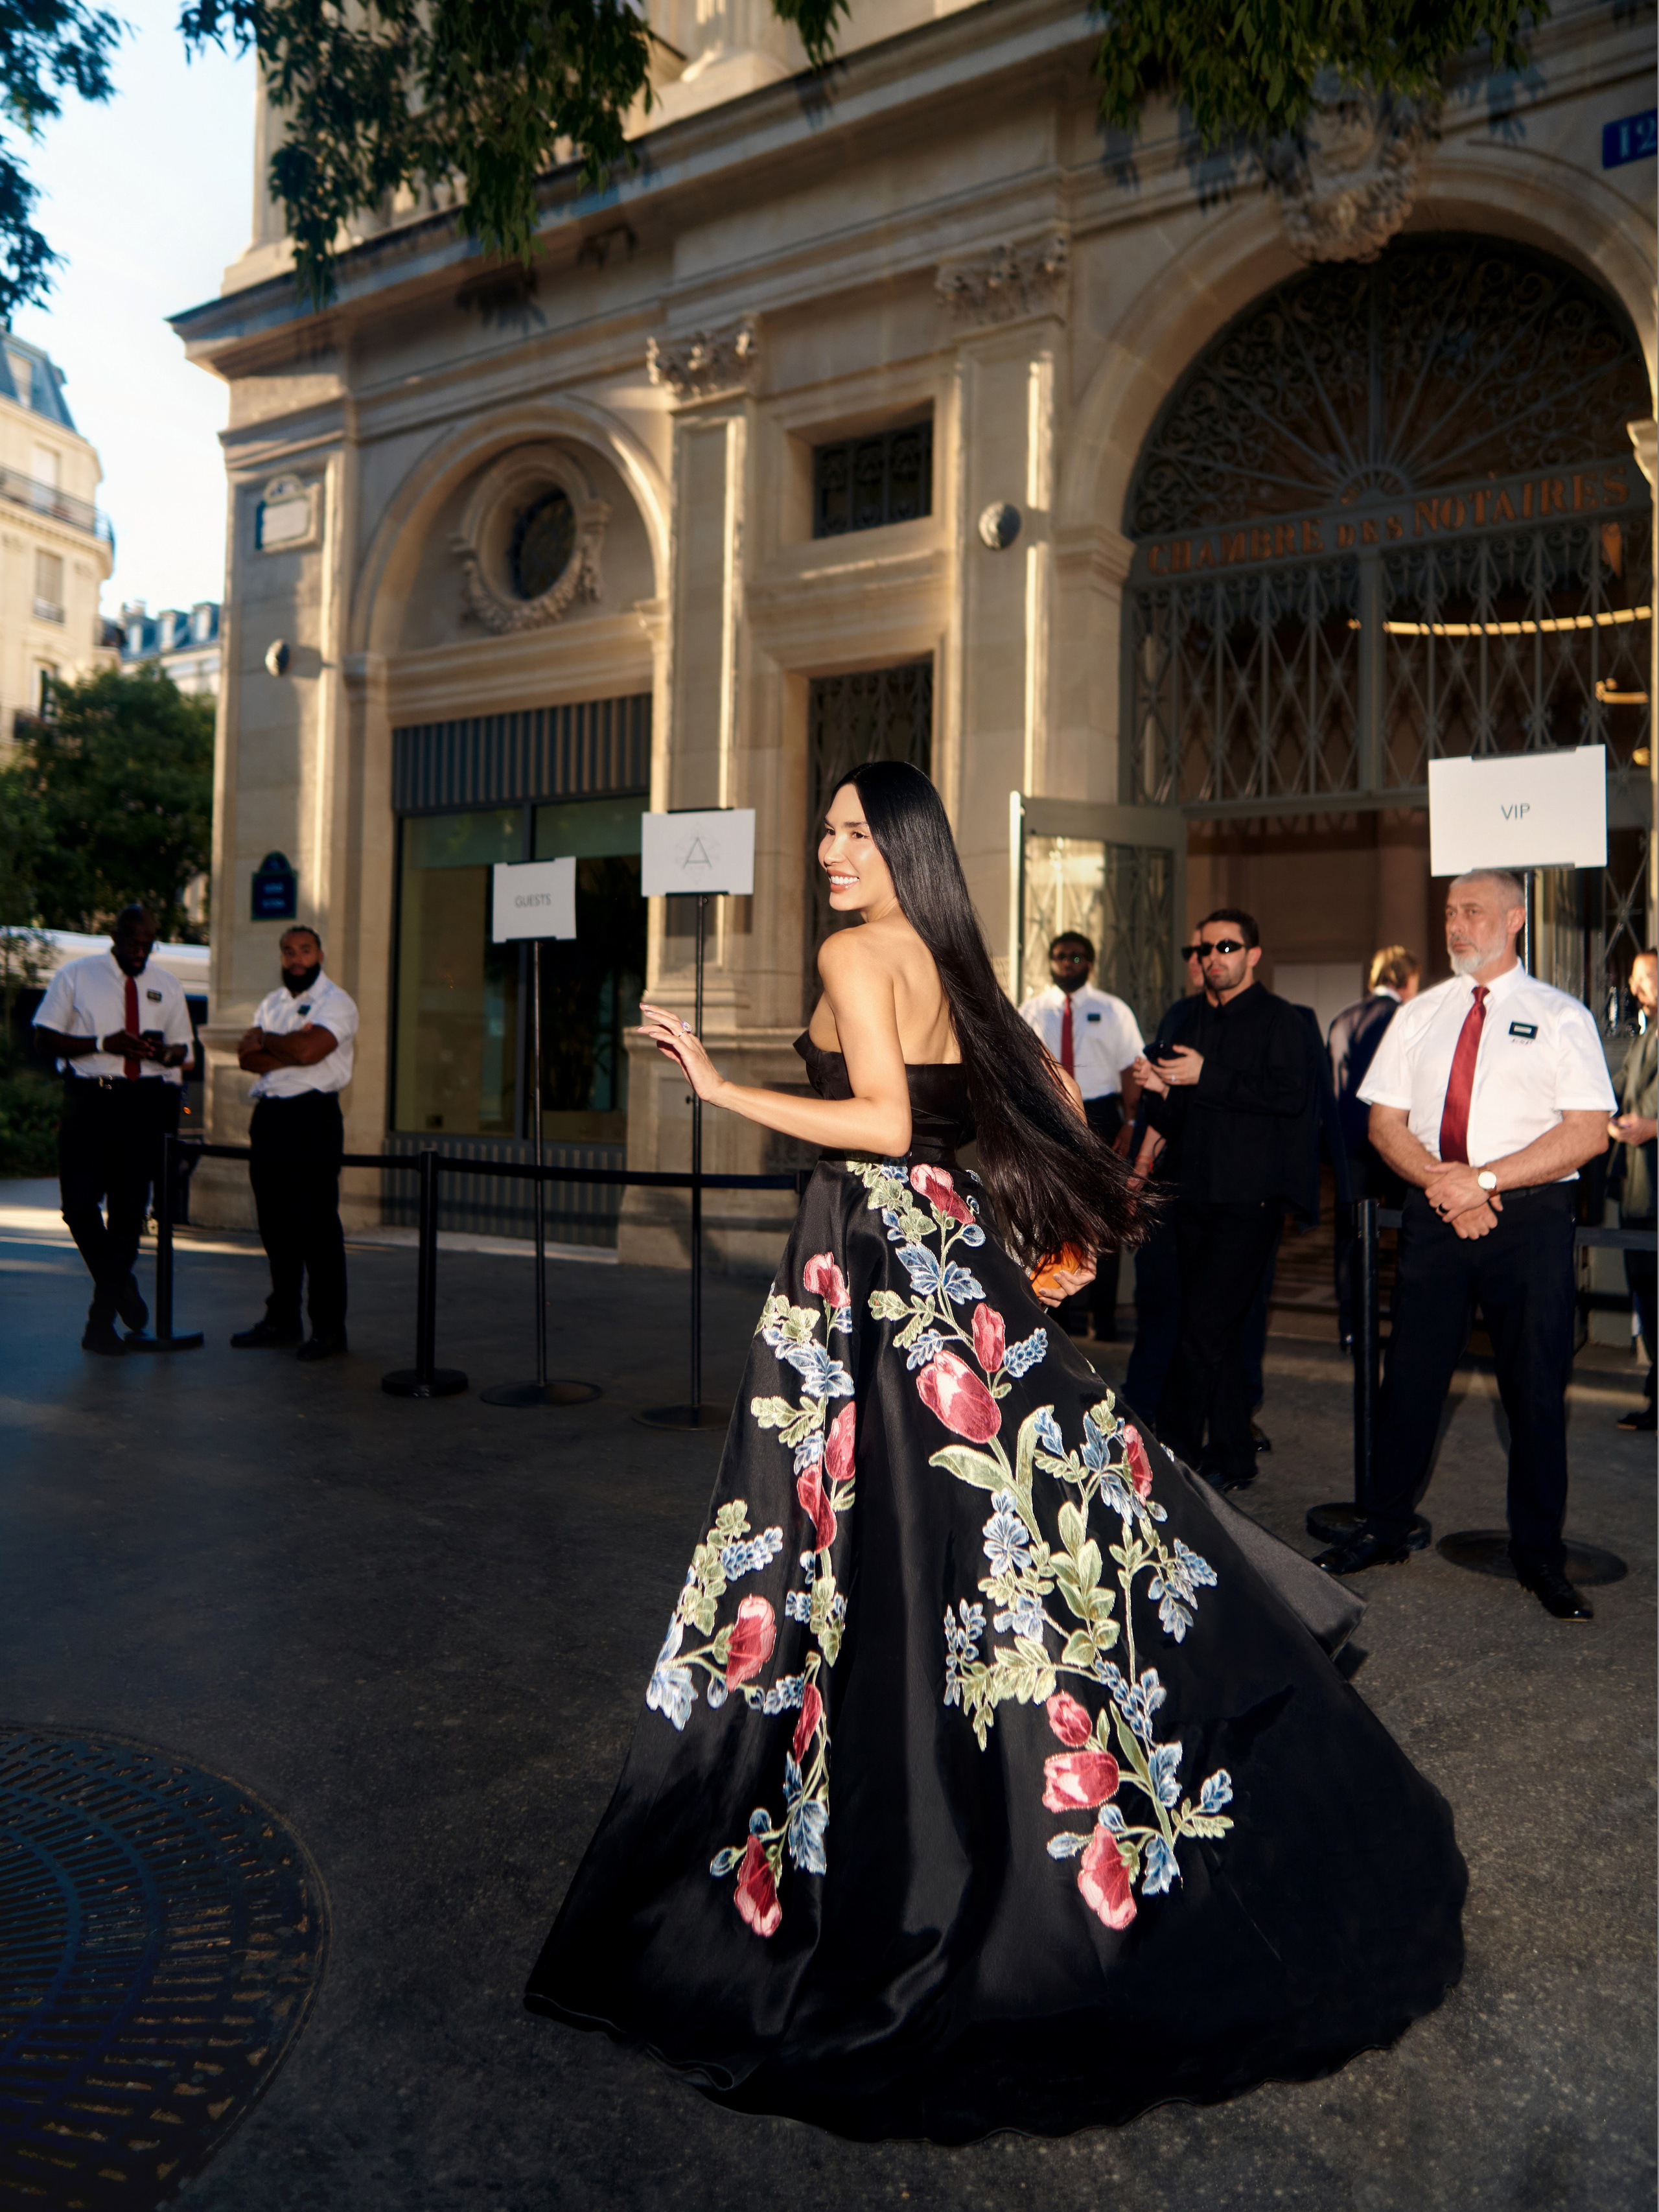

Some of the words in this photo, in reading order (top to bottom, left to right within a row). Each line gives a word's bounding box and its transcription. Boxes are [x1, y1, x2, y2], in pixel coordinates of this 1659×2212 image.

[1148, 518, 1325, 576] CHAMBRE
[1336, 515, 1403, 549] DES
[1414, 466, 1629, 537] NOTAIRES
[1500, 802, 1531, 821] VIP
[682, 836, 713, 870] A
[514, 892, 551, 908] GUESTS
